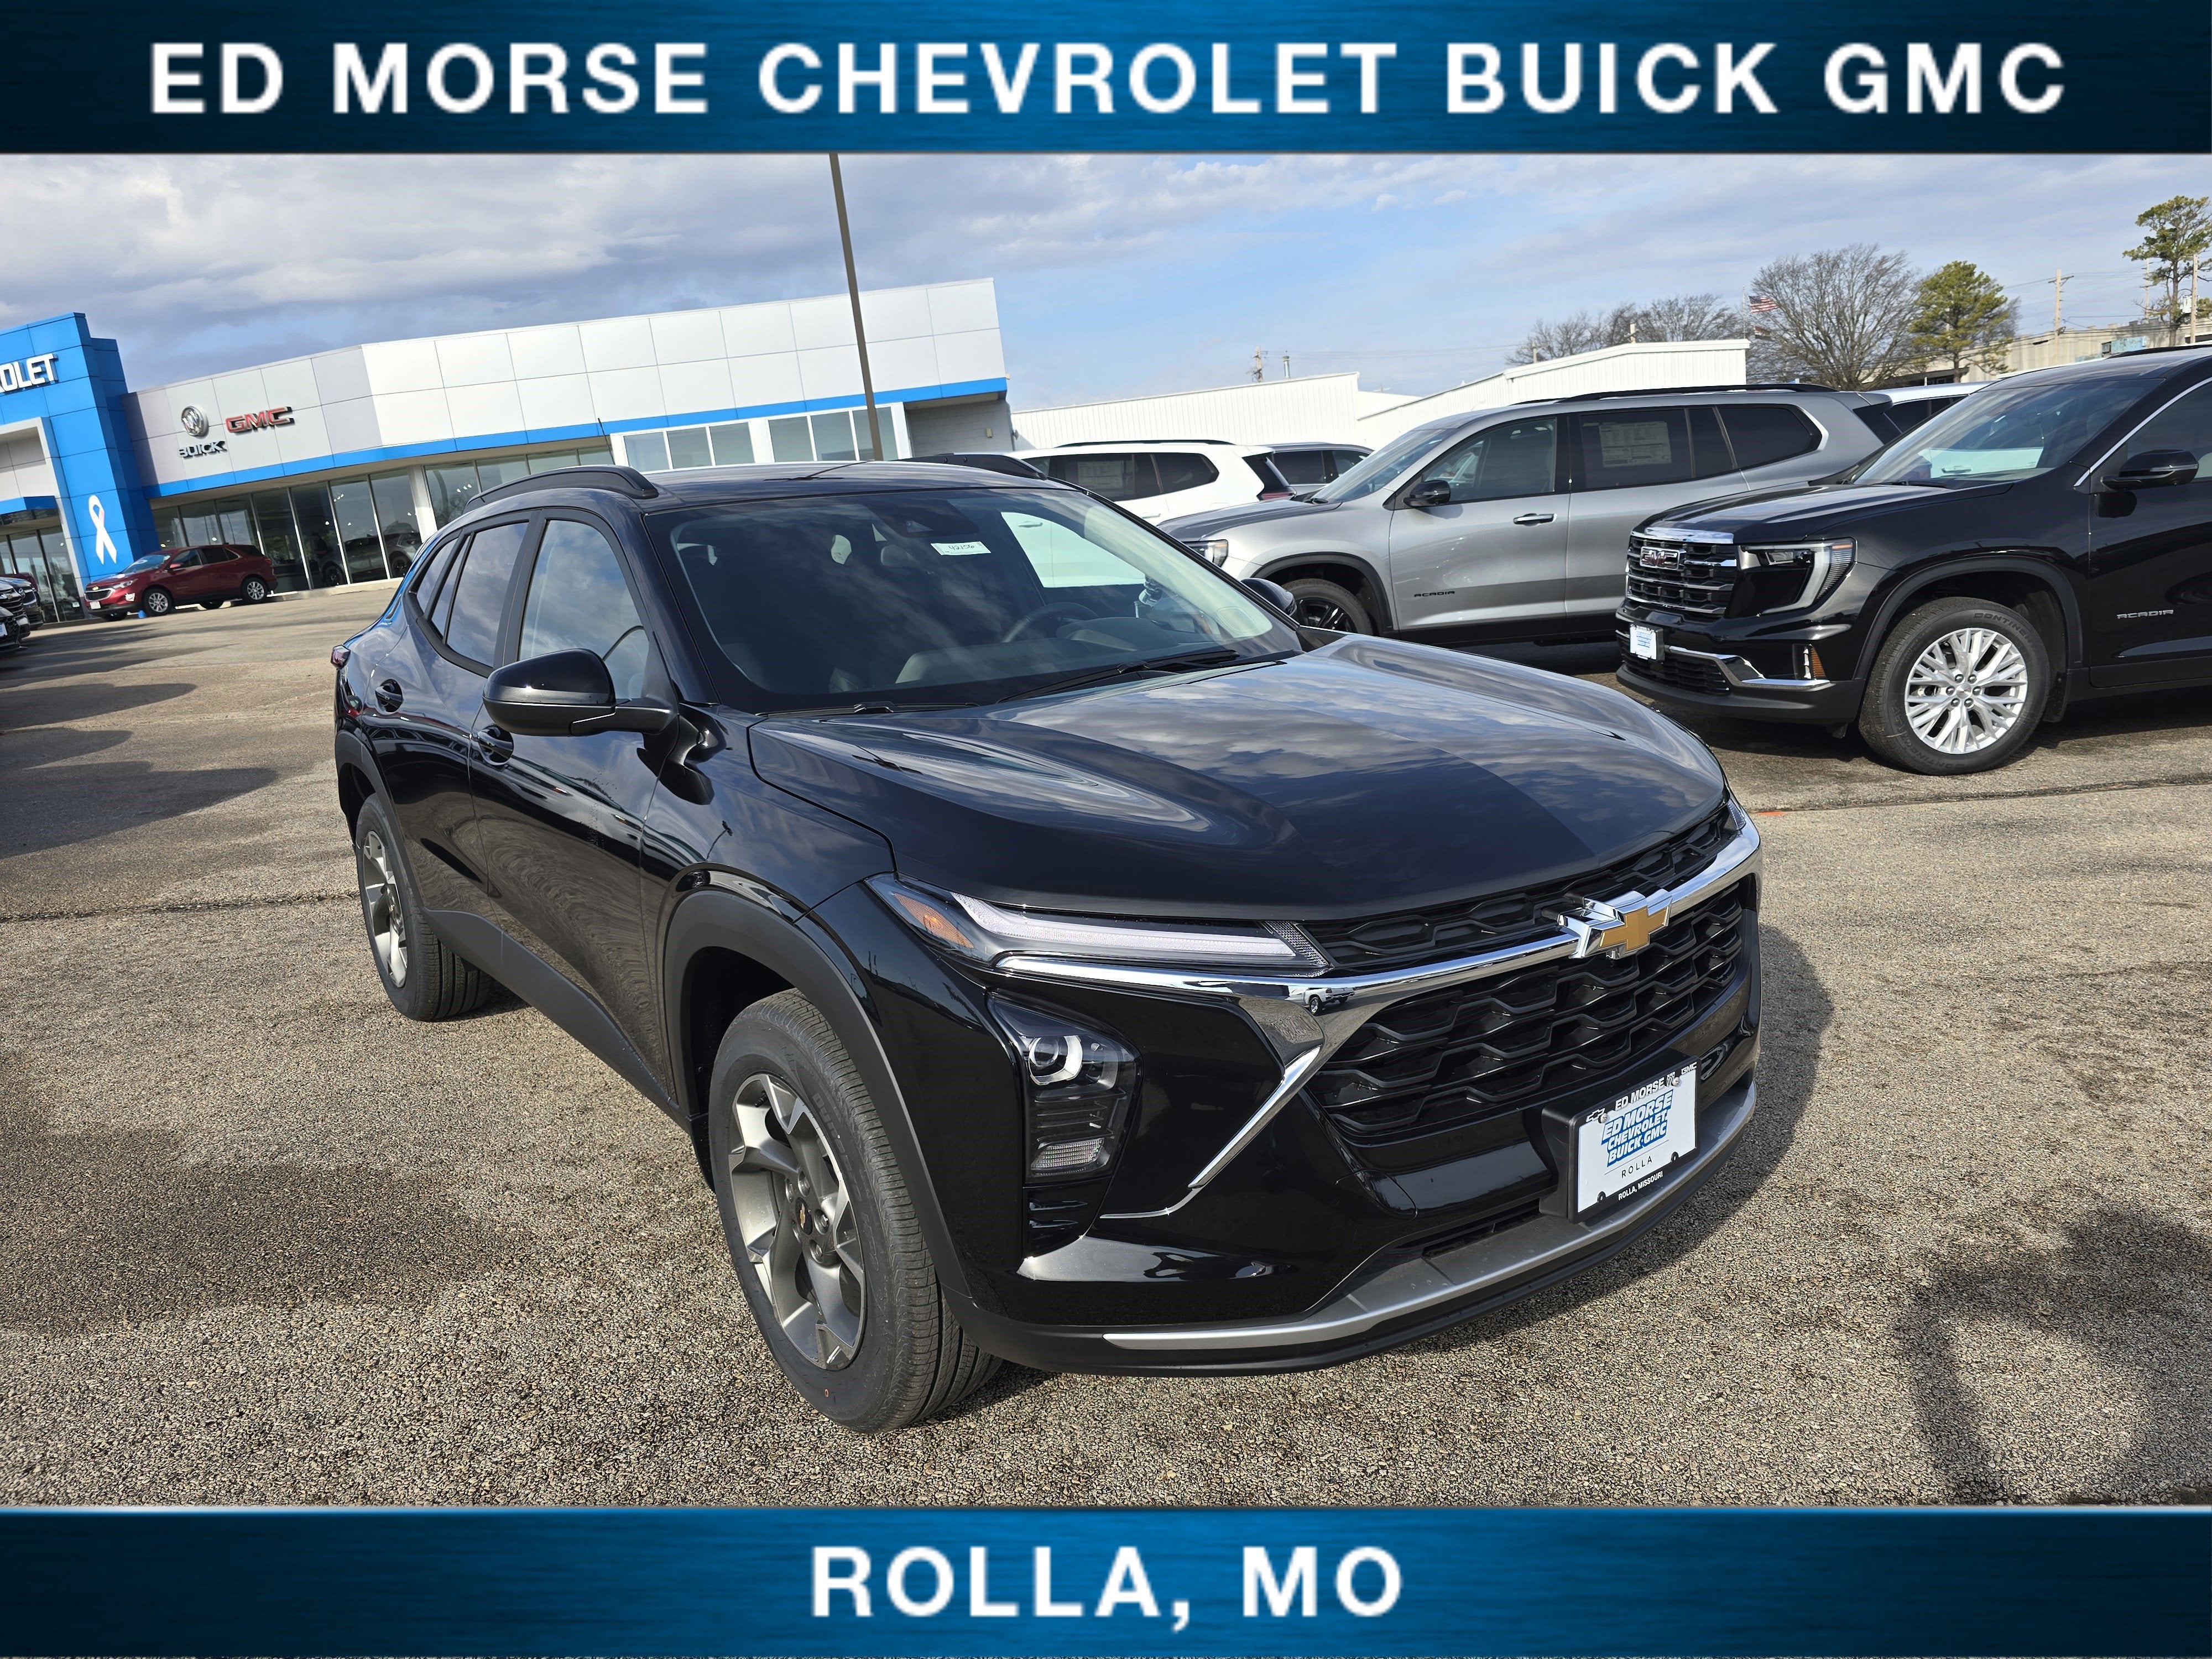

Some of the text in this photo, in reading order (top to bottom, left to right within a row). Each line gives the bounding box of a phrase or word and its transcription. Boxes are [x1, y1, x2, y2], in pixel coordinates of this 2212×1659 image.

[0, 353, 58, 393] OLET
[226, 407, 294, 433] GMC
[178, 441, 226, 458] BUICK
[1641, 549, 1678, 568] GMC
[2116, 609, 2174, 619] ACADIA
[1681, 1061, 1697, 1075] GMC
[1615, 1077, 1665, 1112] ED MORSE
[1602, 1090, 1673, 1141] ED MORSE
[1608, 1121, 1667, 1164] BUICK GMC
[1621, 1155, 1652, 1178] ROLLA
[1618, 1170, 1663, 1201] ROLLA, MISSOURI
